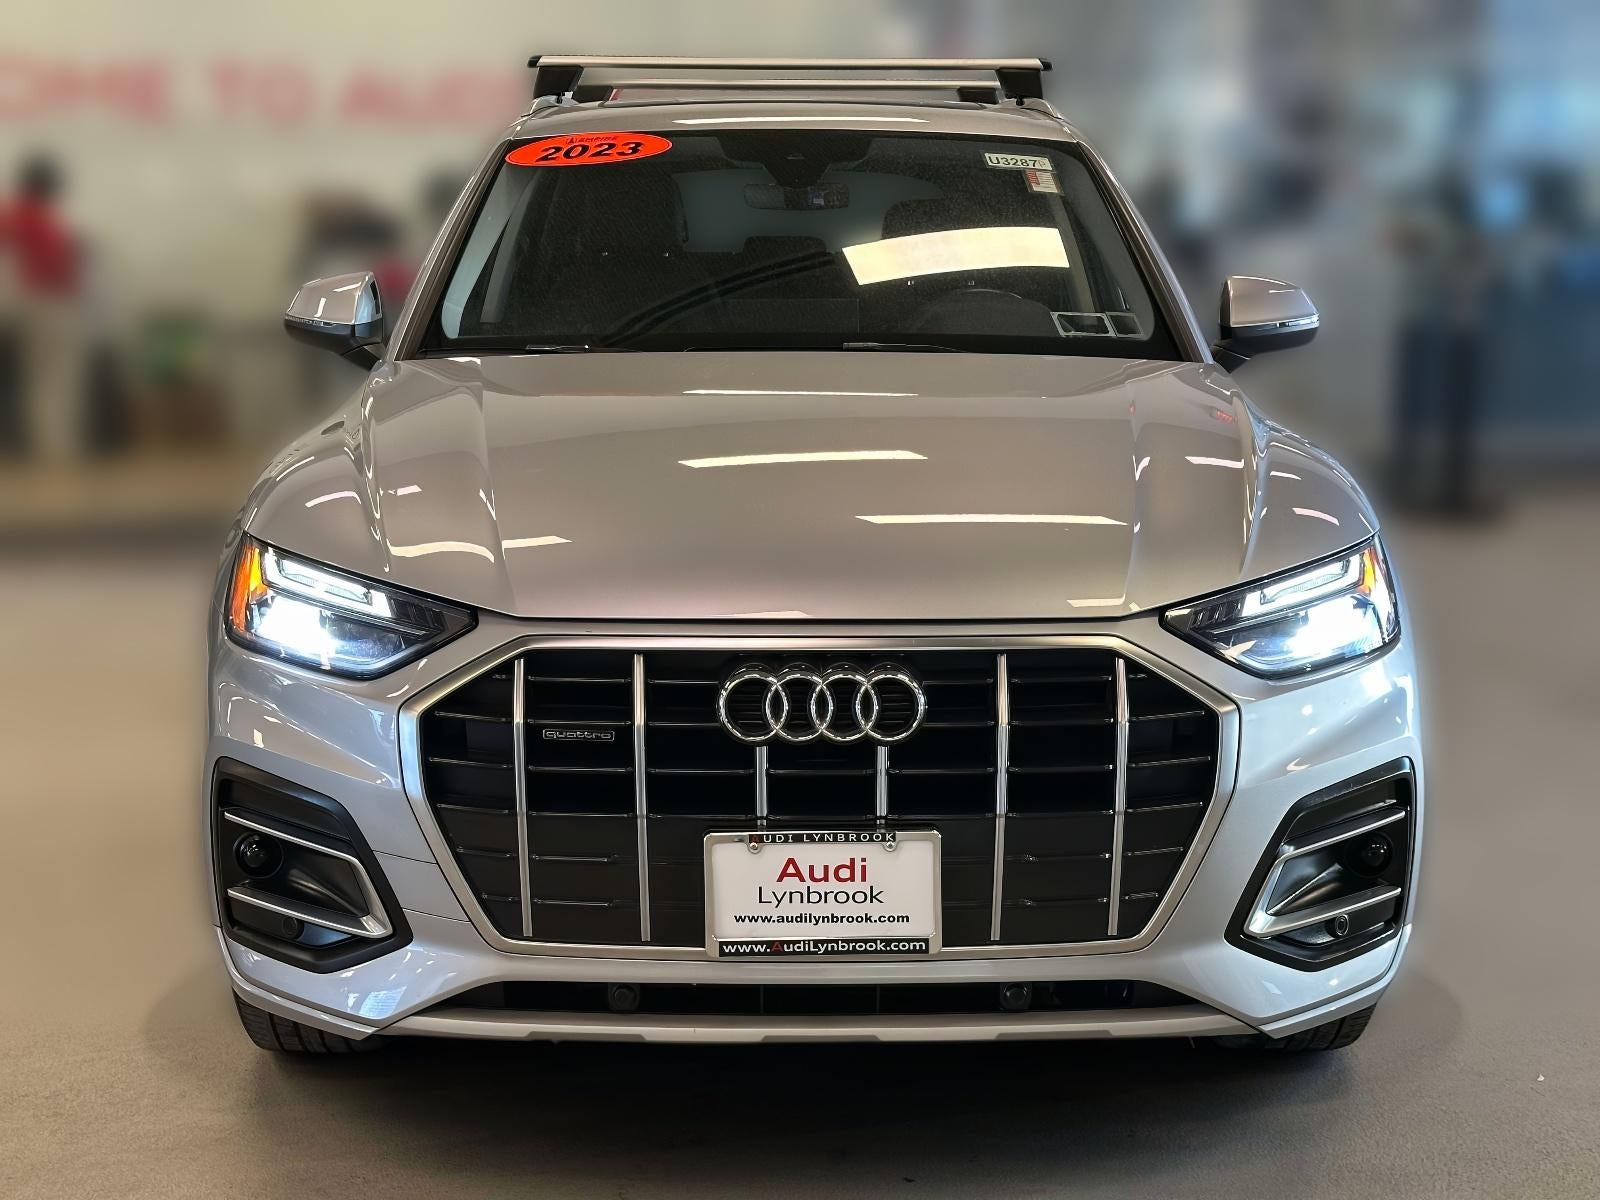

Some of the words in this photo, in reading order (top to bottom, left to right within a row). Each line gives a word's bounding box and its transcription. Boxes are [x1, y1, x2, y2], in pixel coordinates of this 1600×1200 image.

[535, 142, 645, 162] 2023
[546, 731, 612, 739] quattro
[751, 832, 794, 844] AUDI
[803, 832, 895, 843] LYNBROOK
[776, 857, 868, 883] Audi
[758, 886, 885, 908] Lynbrook
[734, 913, 910, 926] www.audilynbrook.com
[723, 940, 926, 954] www.AudiLynbrook.com
